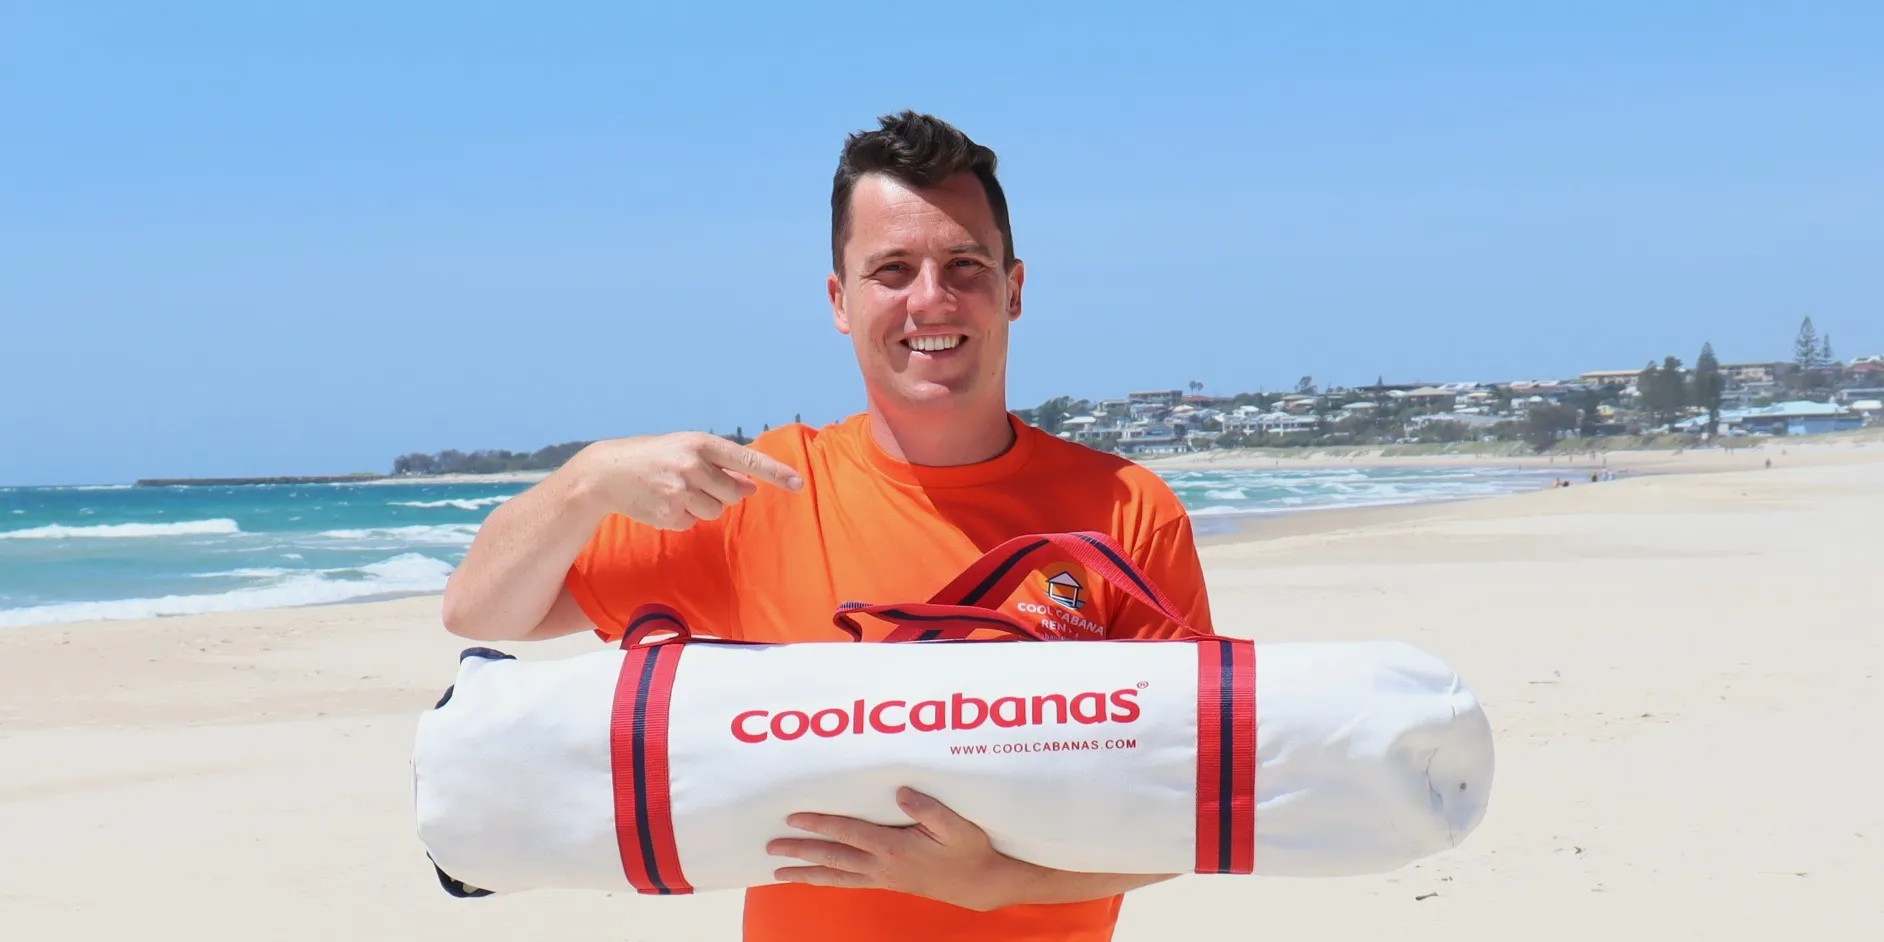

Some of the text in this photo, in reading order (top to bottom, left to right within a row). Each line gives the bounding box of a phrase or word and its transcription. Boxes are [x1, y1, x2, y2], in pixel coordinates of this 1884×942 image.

[1017, 602, 1053, 615] COOL
[731, 688, 1141, 743] coolcabanas
[950, 739, 1137, 755] WWW.COOLCABANAS.COM
